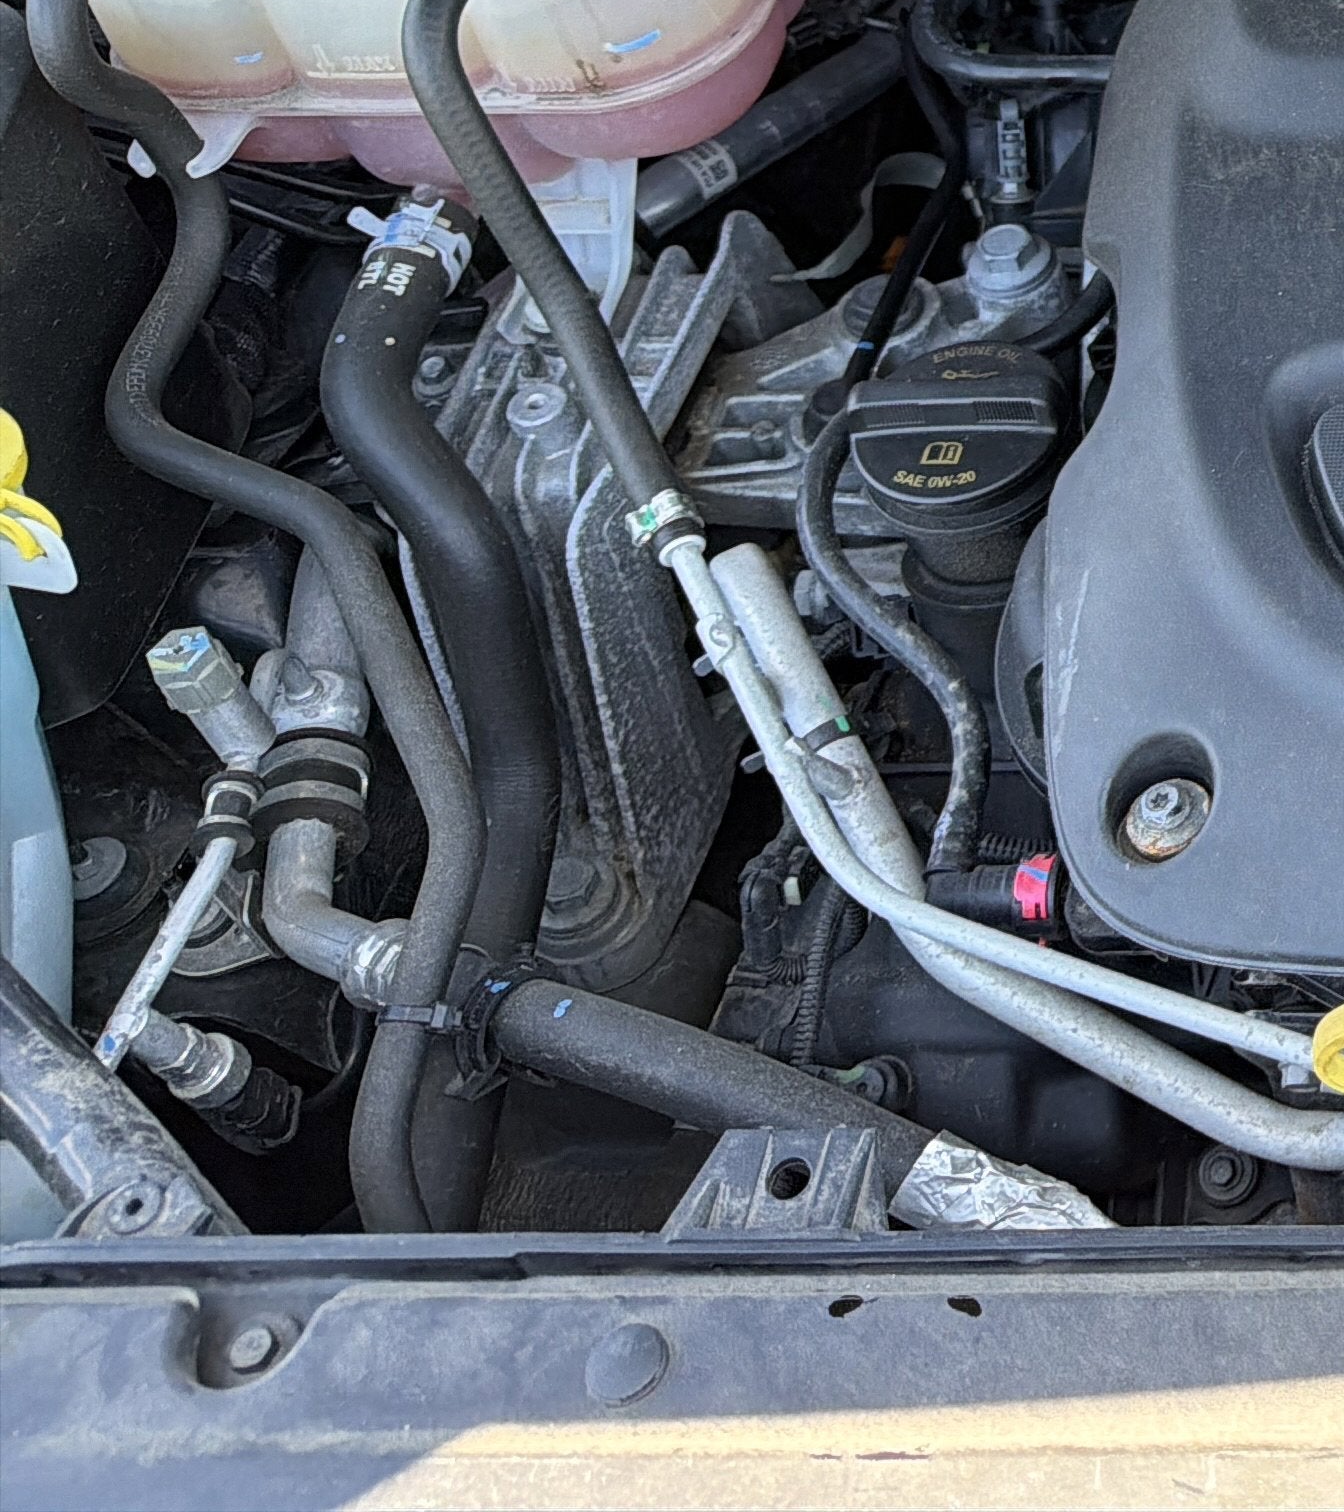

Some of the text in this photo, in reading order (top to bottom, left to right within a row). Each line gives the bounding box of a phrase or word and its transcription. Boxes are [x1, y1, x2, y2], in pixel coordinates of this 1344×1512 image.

[382, 262, 417, 297] HOT
[933, 345, 1024, 364] ENGINE OIL
[893, 470, 977, 489] SAE 0W-20
